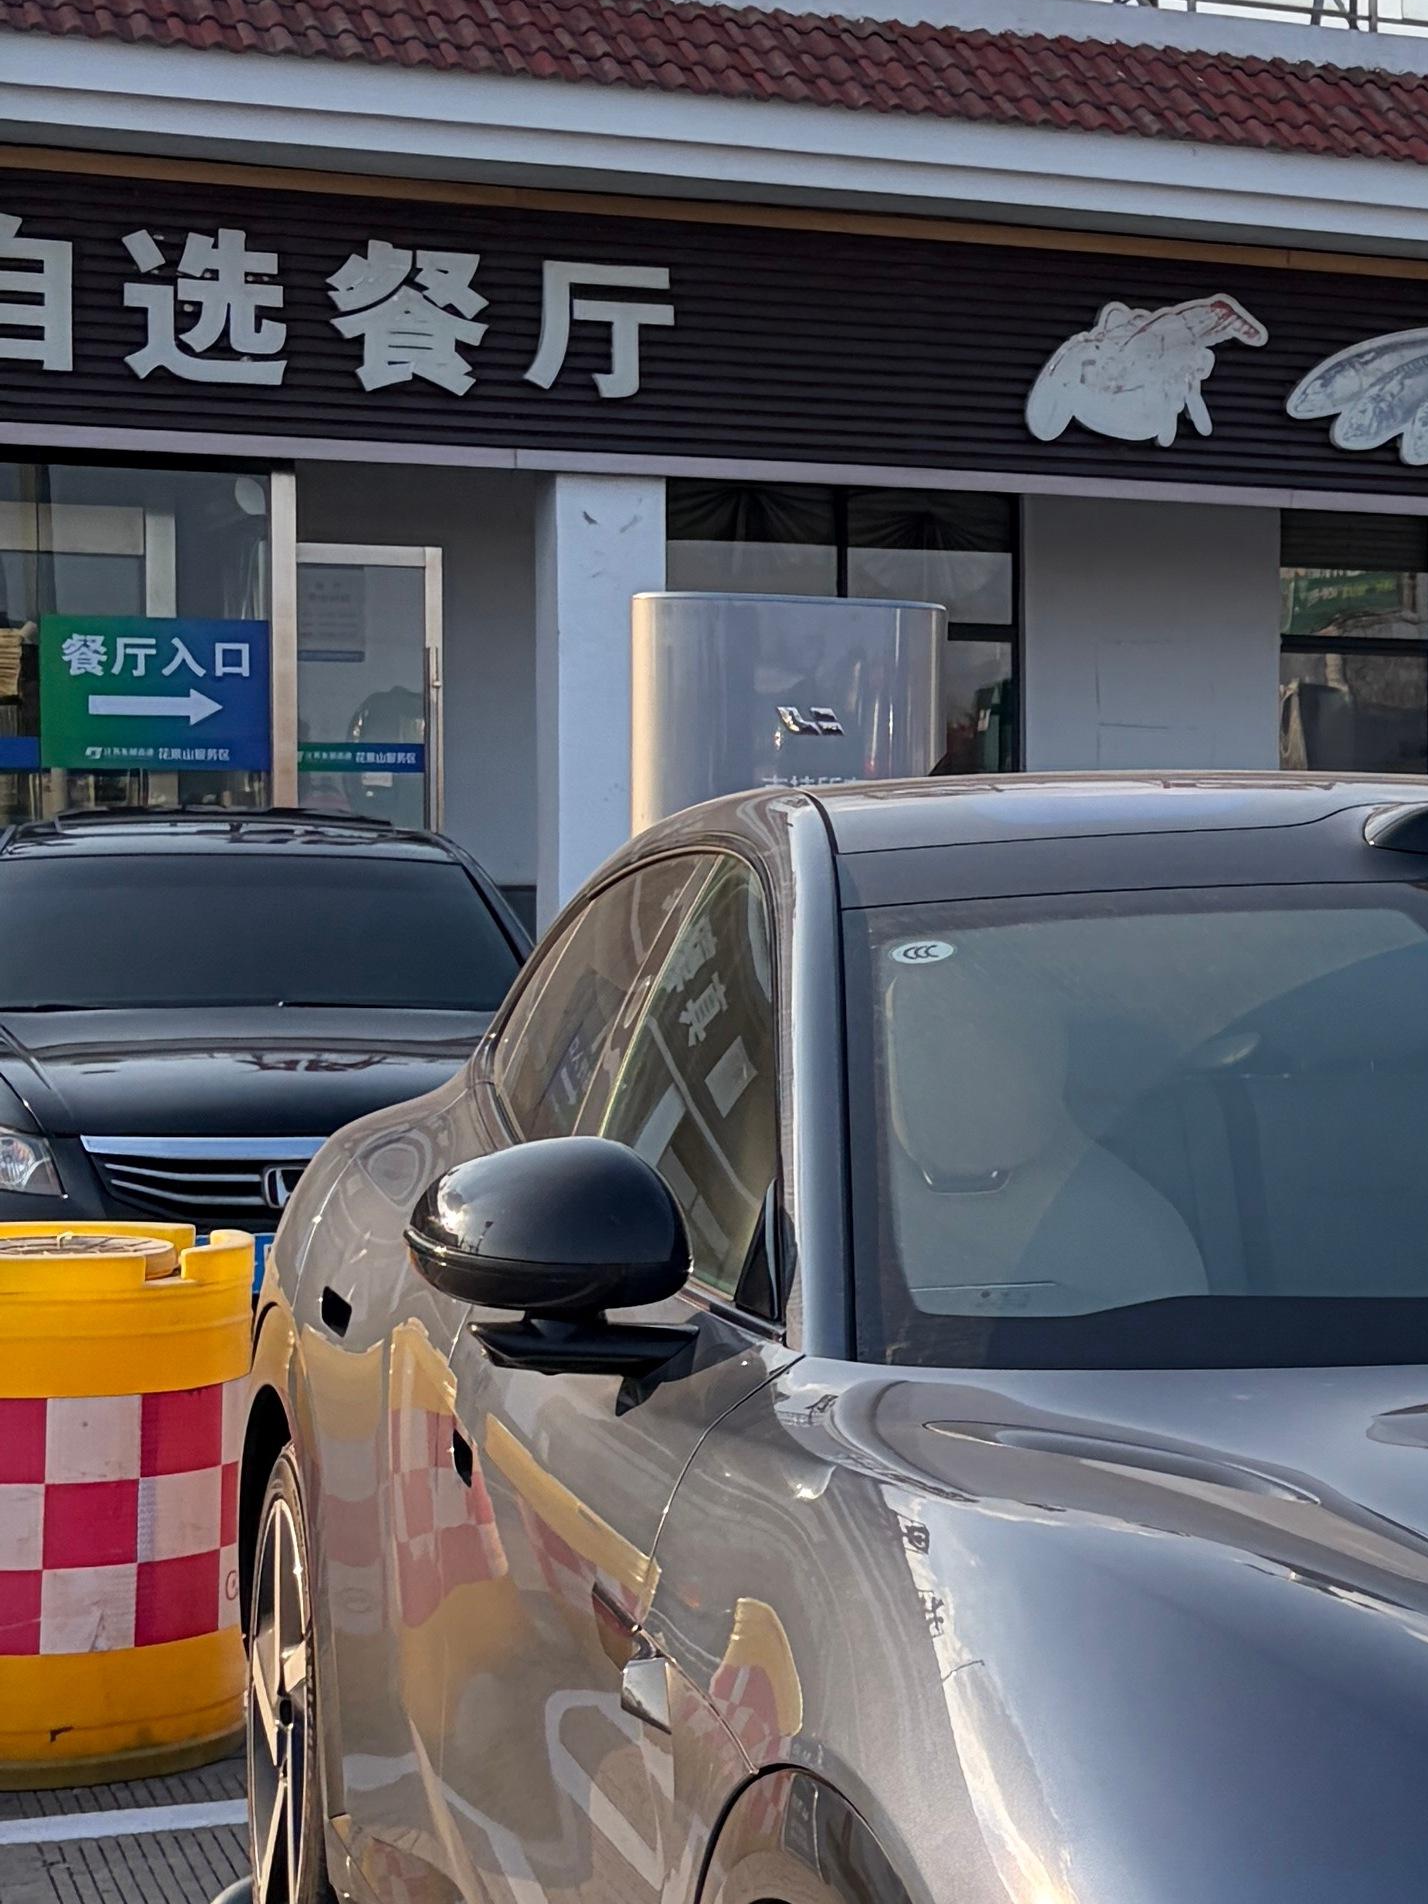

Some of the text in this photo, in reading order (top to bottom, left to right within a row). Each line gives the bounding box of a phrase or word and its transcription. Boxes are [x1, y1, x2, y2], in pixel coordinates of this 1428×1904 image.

[0, 212, 675, 398] 自选餐厅
[61, 632, 251, 678] 餐厅入口
